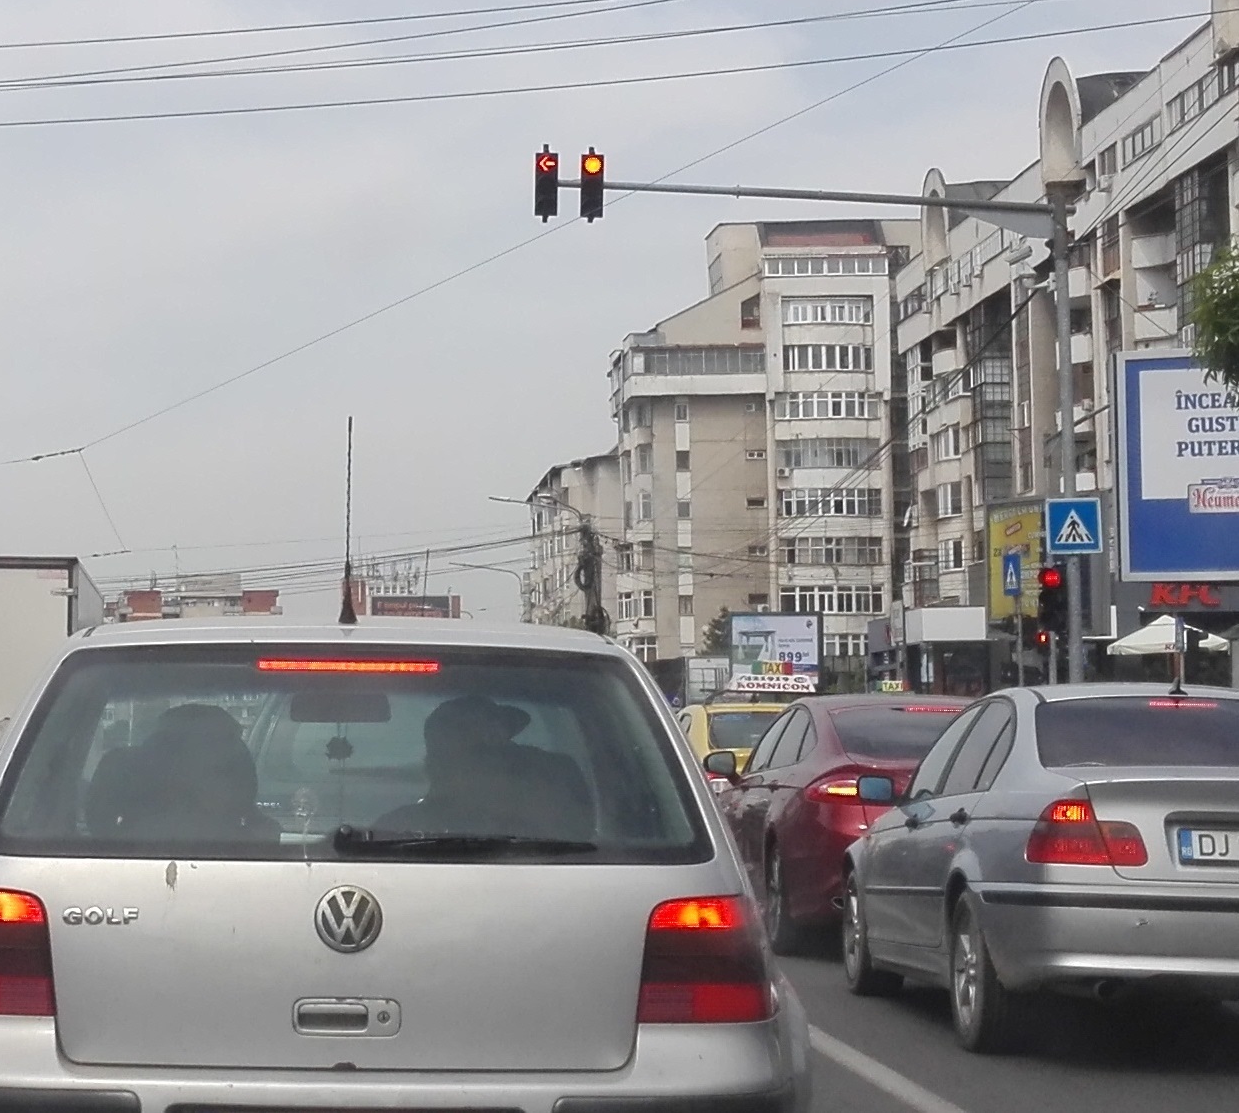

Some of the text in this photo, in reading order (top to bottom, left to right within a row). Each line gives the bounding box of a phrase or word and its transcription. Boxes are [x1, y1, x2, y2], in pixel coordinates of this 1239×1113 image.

[1150, 583, 1220, 606] KFC
[779, 652, 802, 662] 899
[1198, 834, 1229, 857] DJ
[62, 906, 139, 926] GOLF
